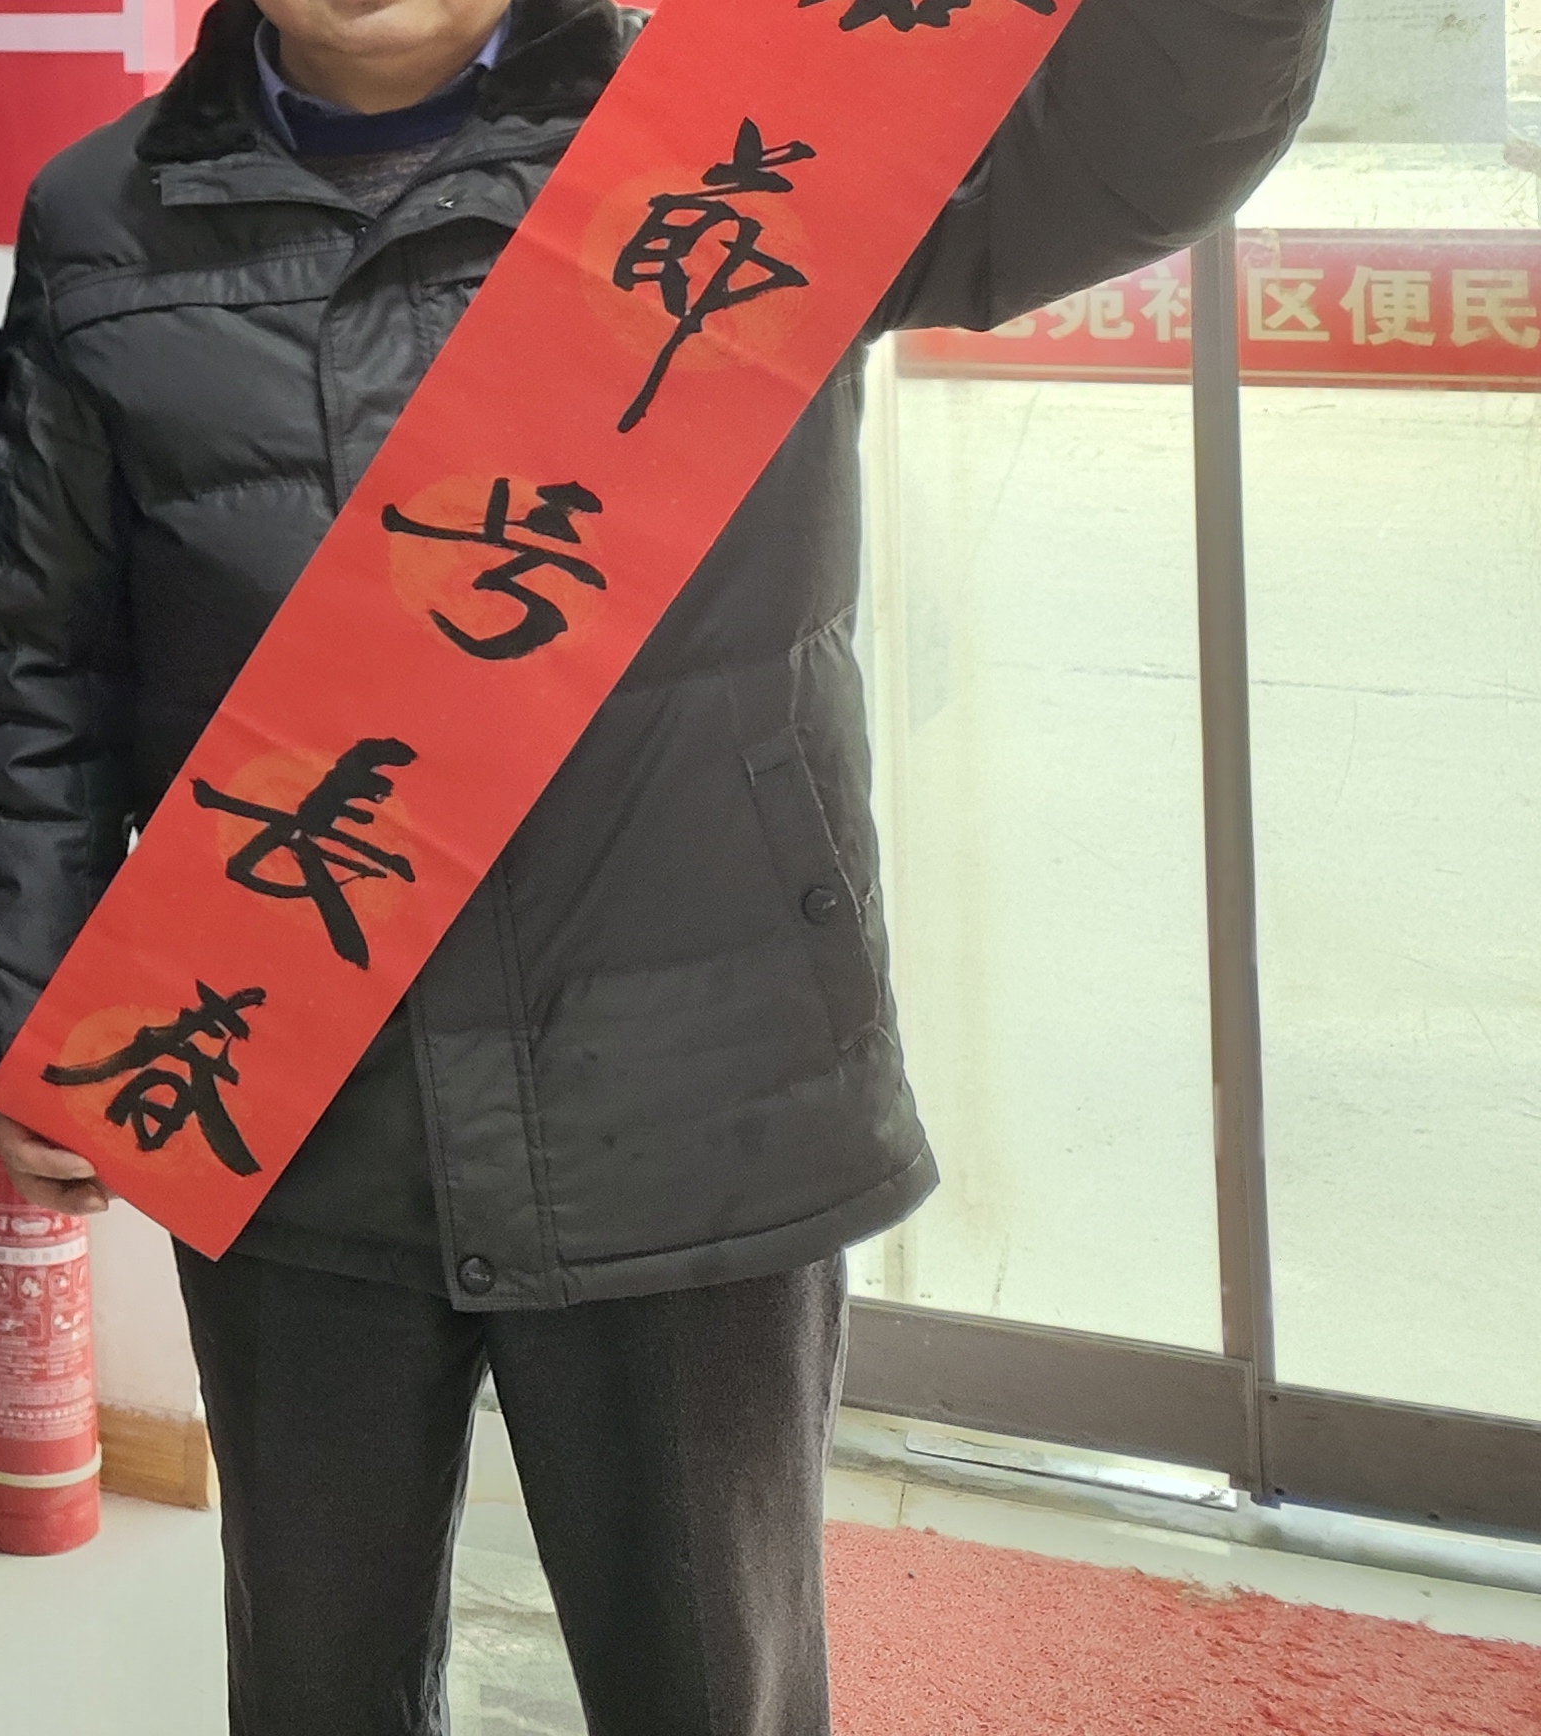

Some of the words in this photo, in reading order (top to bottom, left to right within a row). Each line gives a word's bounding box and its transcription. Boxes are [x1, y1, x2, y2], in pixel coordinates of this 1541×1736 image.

[992, 264, 1540, 349] 苑社区便民
